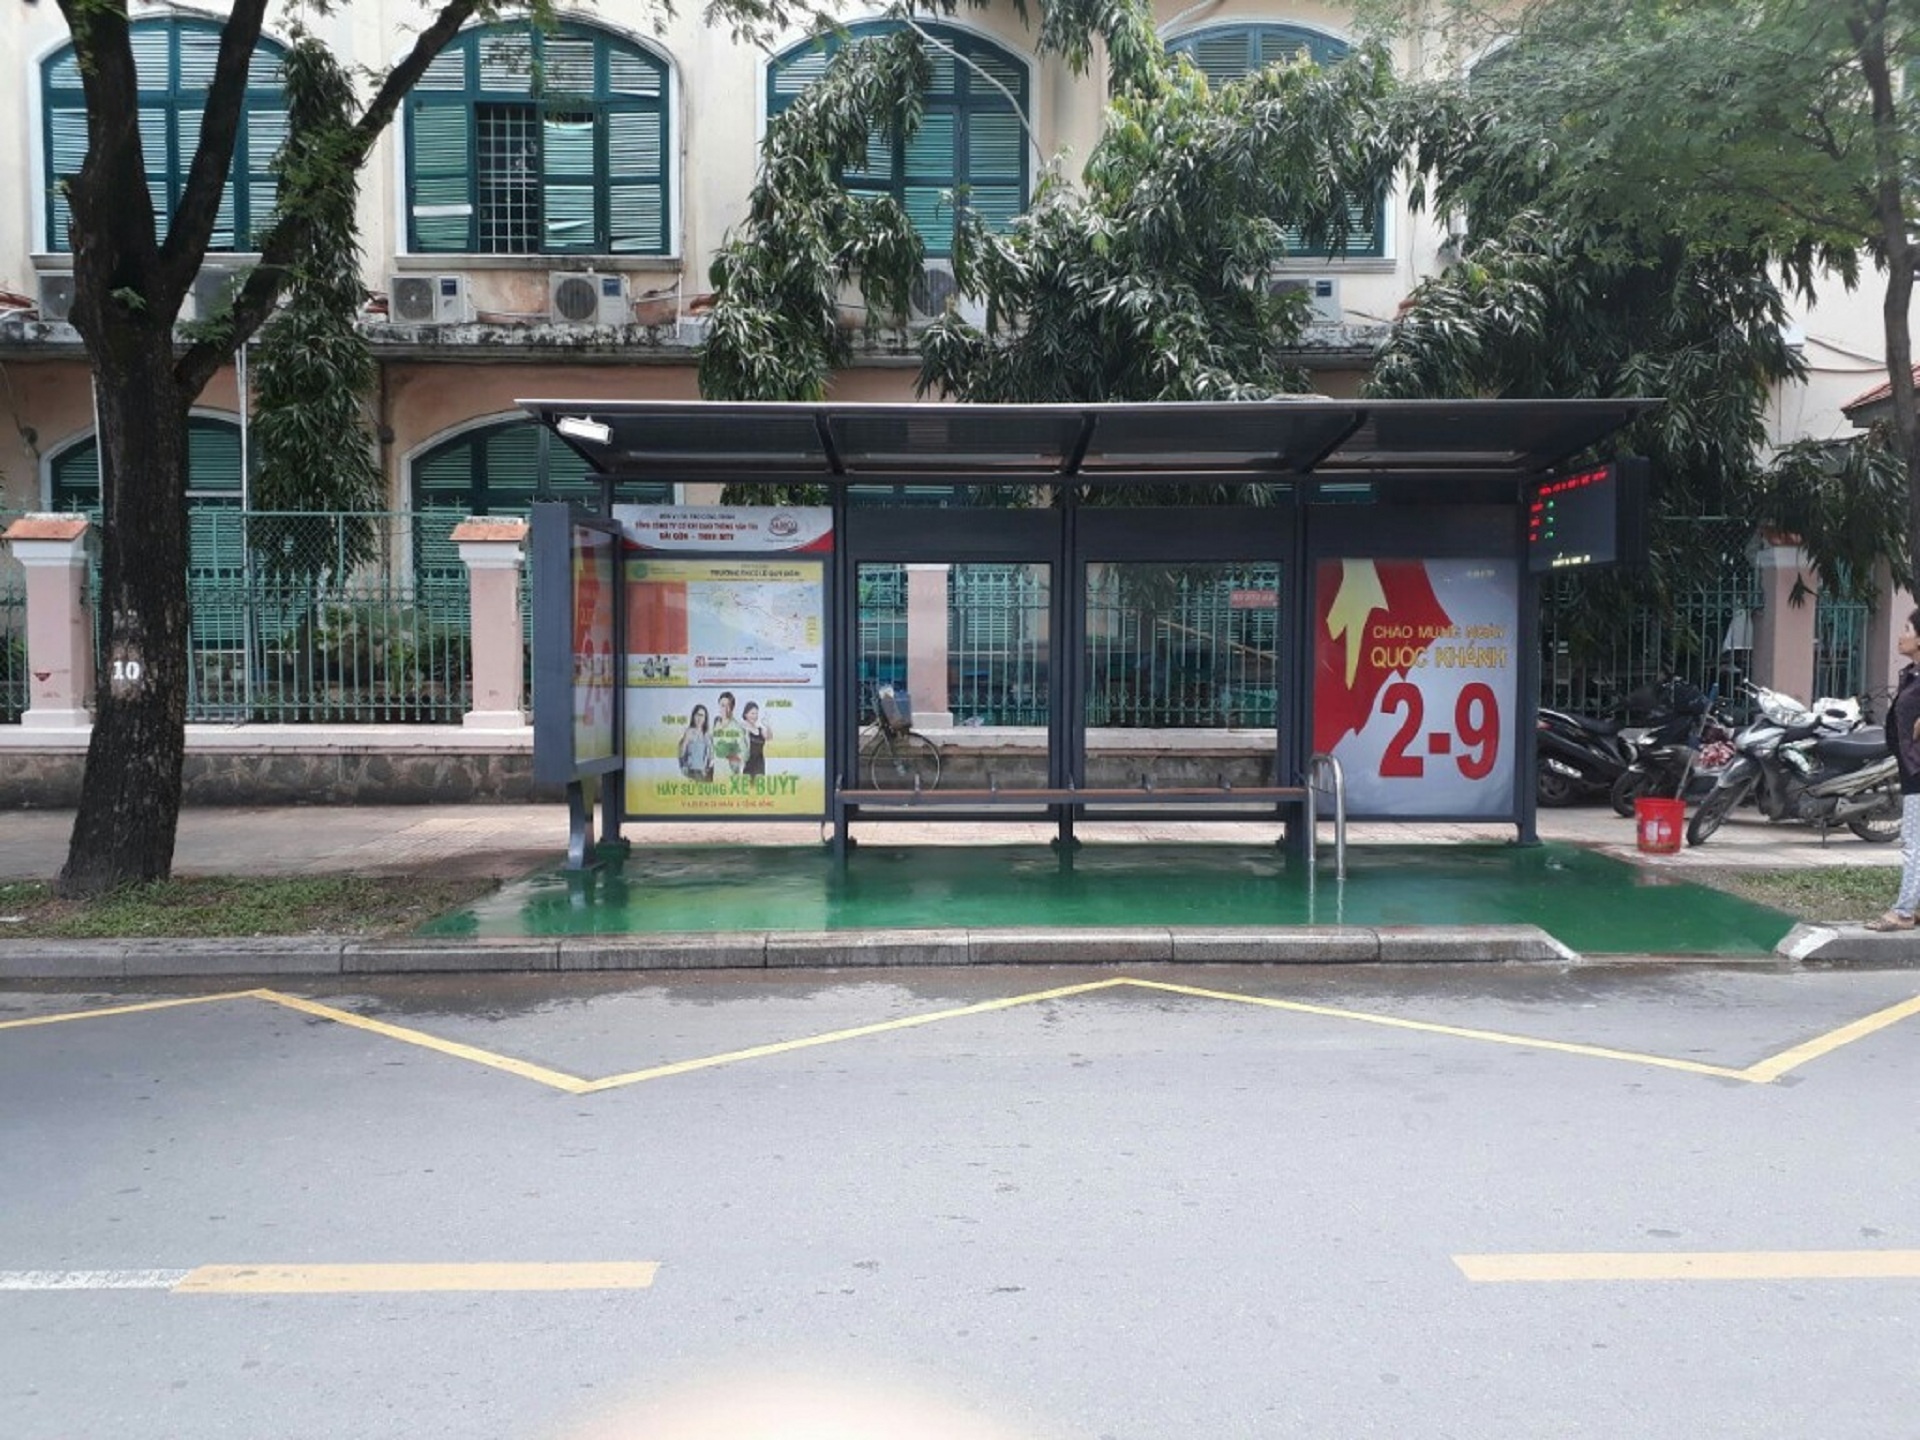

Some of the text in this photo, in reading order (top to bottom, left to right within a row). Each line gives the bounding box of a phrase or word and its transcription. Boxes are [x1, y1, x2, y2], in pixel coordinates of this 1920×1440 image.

[113, 660, 140, 680] 10
[1379, 682, 1500, 780] 2-9
[729, 774, 751, 796] XE
[755, 770, 800, 797] BUÝT
